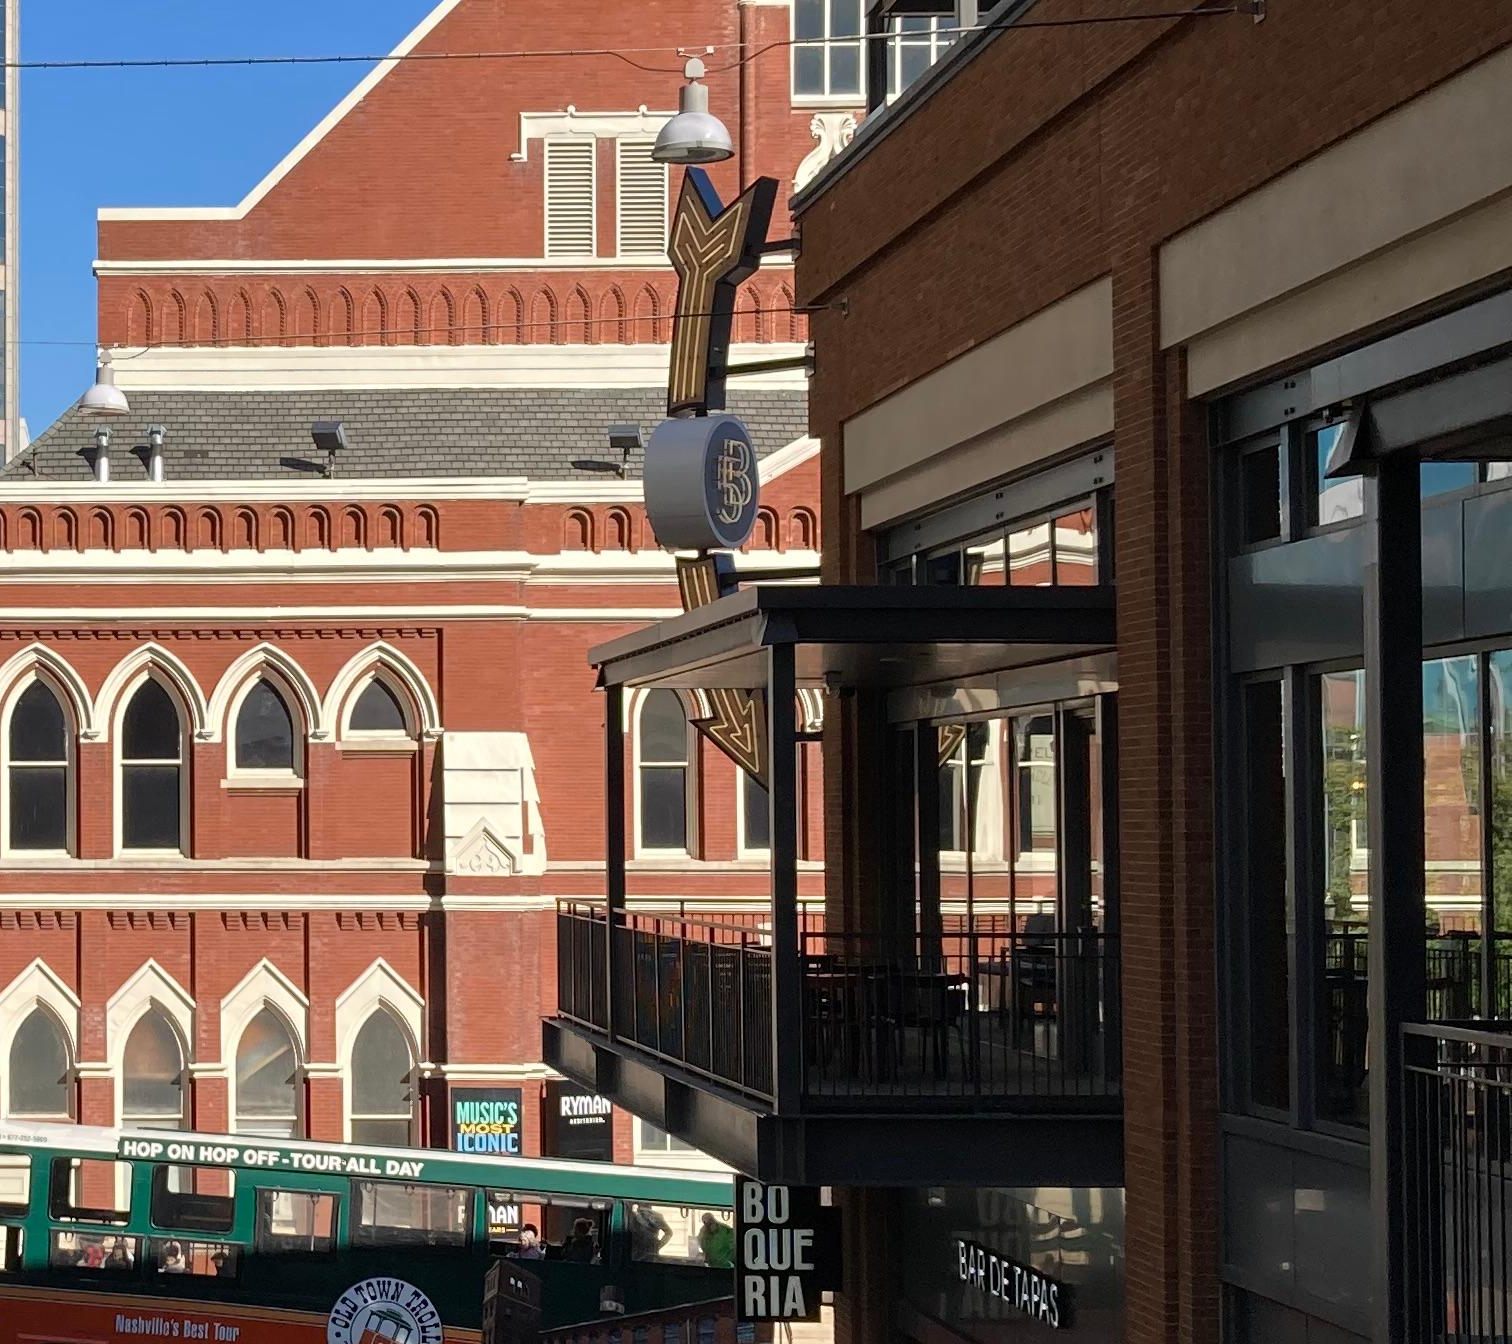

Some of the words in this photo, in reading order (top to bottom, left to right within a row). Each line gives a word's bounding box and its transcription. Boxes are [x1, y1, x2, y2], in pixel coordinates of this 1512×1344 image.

[560, 1094, 612, 1116] RYMAN
[457, 1132, 519, 1153] ICONIC
[460, 1123, 515, 1134] MOST
[123, 1140, 164, 1158] HOP
[167, 1143, 195, 1161] ON
[199, 1145, 239, 1163] HOP
[345, 1157, 381, 1174] ALL
[385, 1160, 425, 1177] DAY
[743, 1181, 789, 1225] BO
[743, 1227, 815, 1271] QUE
[330, 1296, 359, 1329] OLD
[353, 1279, 405, 1304] TOWN
[744, 1274, 807, 1317] RIA
[957, 1239, 986, 1292] BAR
[988, 1254, 1010, 1302] DE
[1012, 1265, 1060, 1329] TAPAS
[115, 1313, 180, 1337] Nashville's
[183, 1319, 209, 1340] Best
[213, 1321, 240, 1343] Tour
